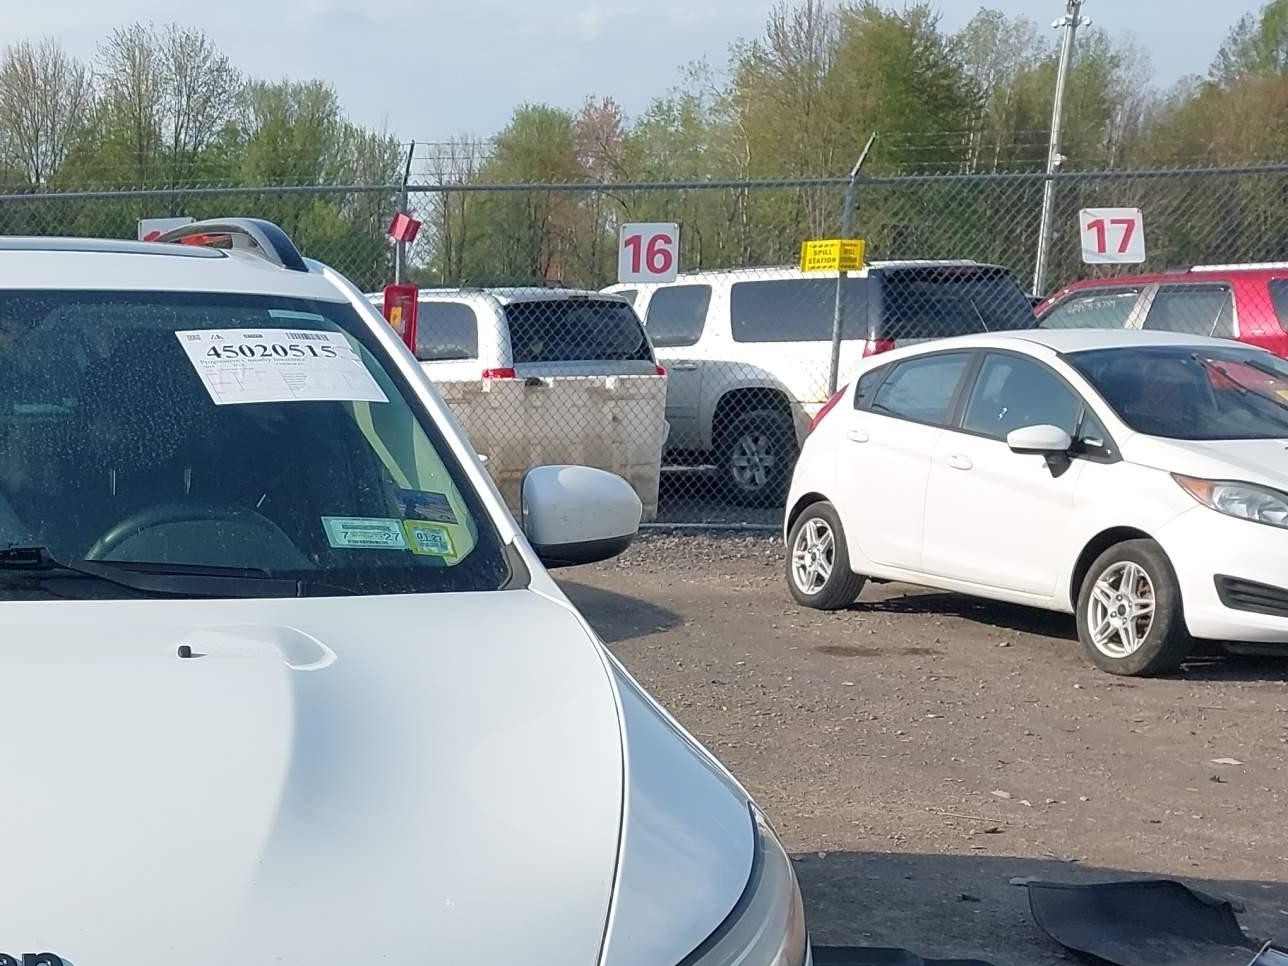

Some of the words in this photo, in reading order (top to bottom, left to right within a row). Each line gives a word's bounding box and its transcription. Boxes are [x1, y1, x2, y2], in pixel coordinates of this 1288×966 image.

[624, 233, 673, 274] 16
[1087, 218, 1136, 254] 17
[206, 343, 337, 359] 45020515
